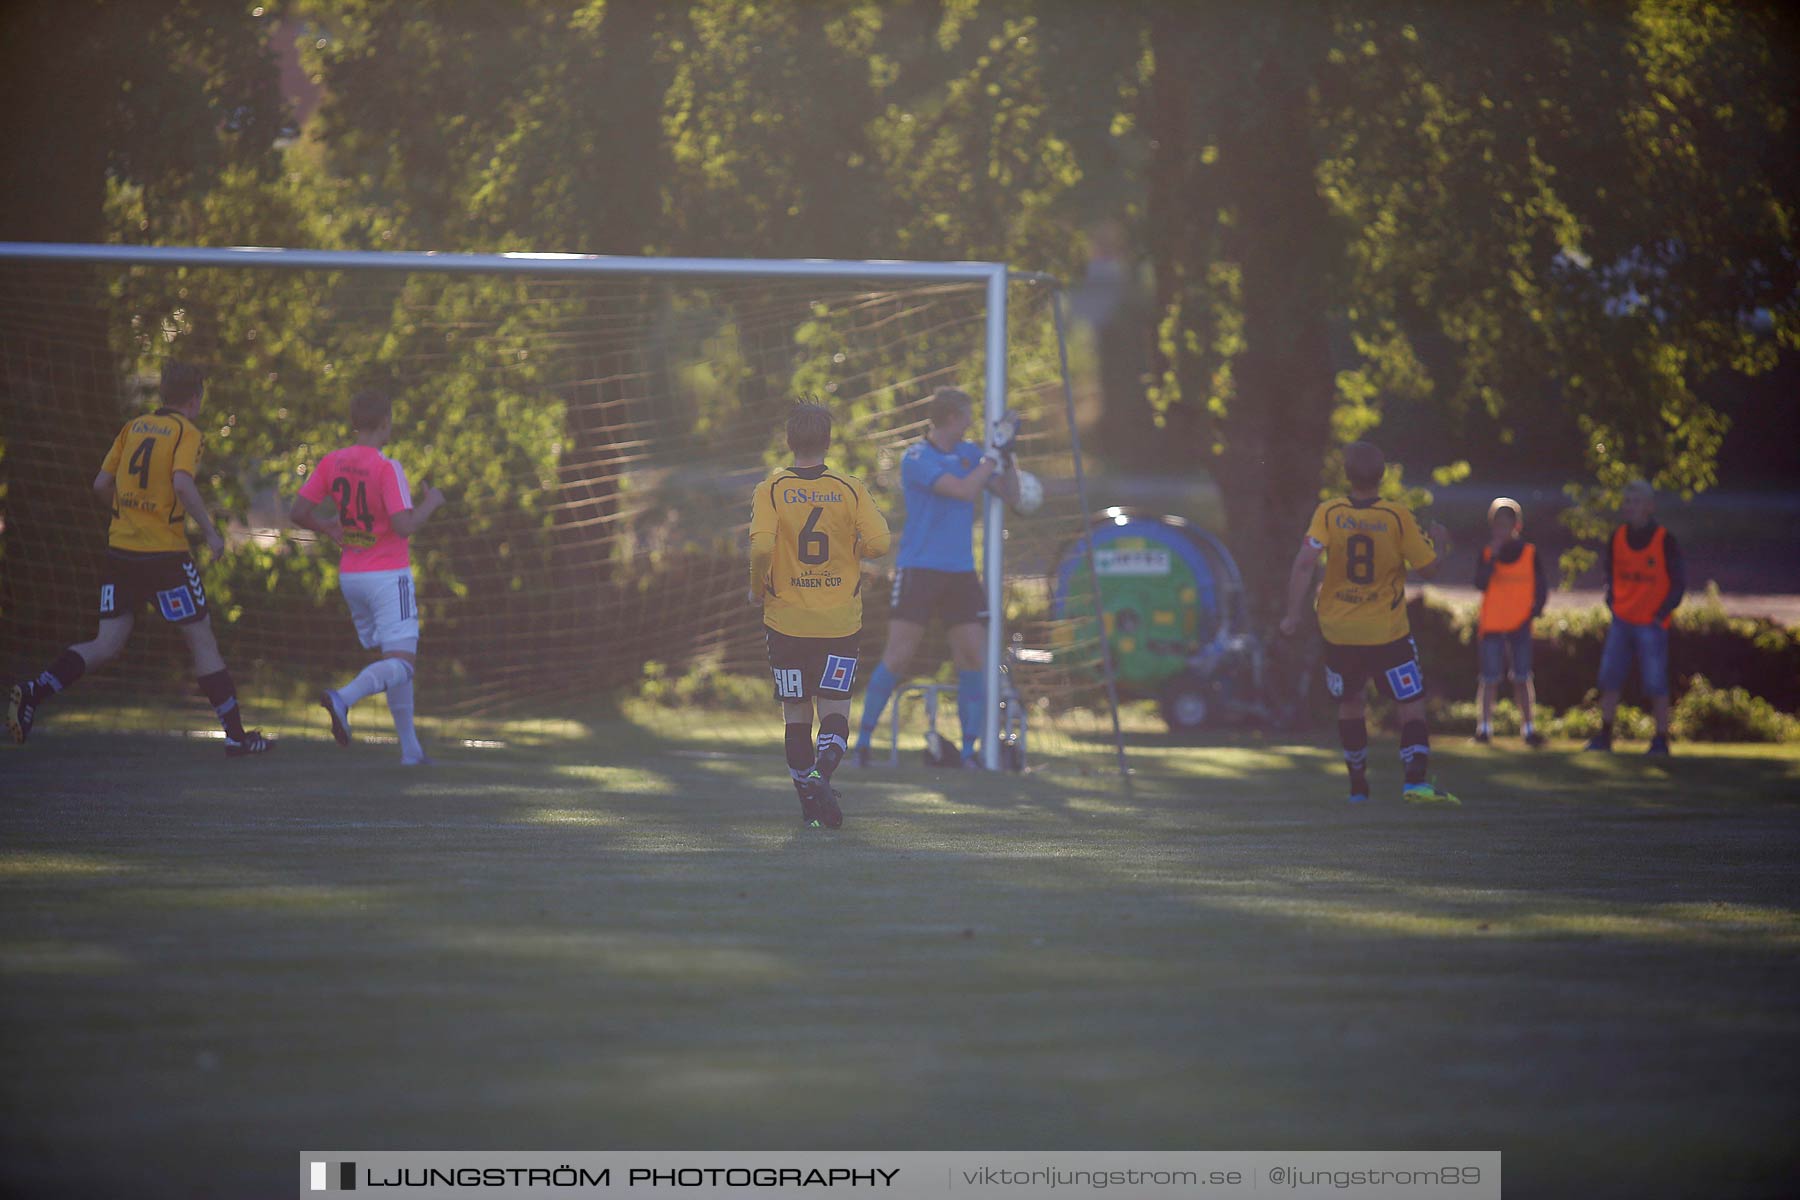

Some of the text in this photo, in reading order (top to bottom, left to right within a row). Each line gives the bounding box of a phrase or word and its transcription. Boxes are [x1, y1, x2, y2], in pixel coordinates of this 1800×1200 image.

[128, 437, 156, 489] 4
[332, 476, 375, 533] 24
[783, 488, 842, 504] GS-Frakt
[797, 507, 830, 565] 6
[1346, 534, 1375, 584] 8
[825, 576, 842, 587] CUP
